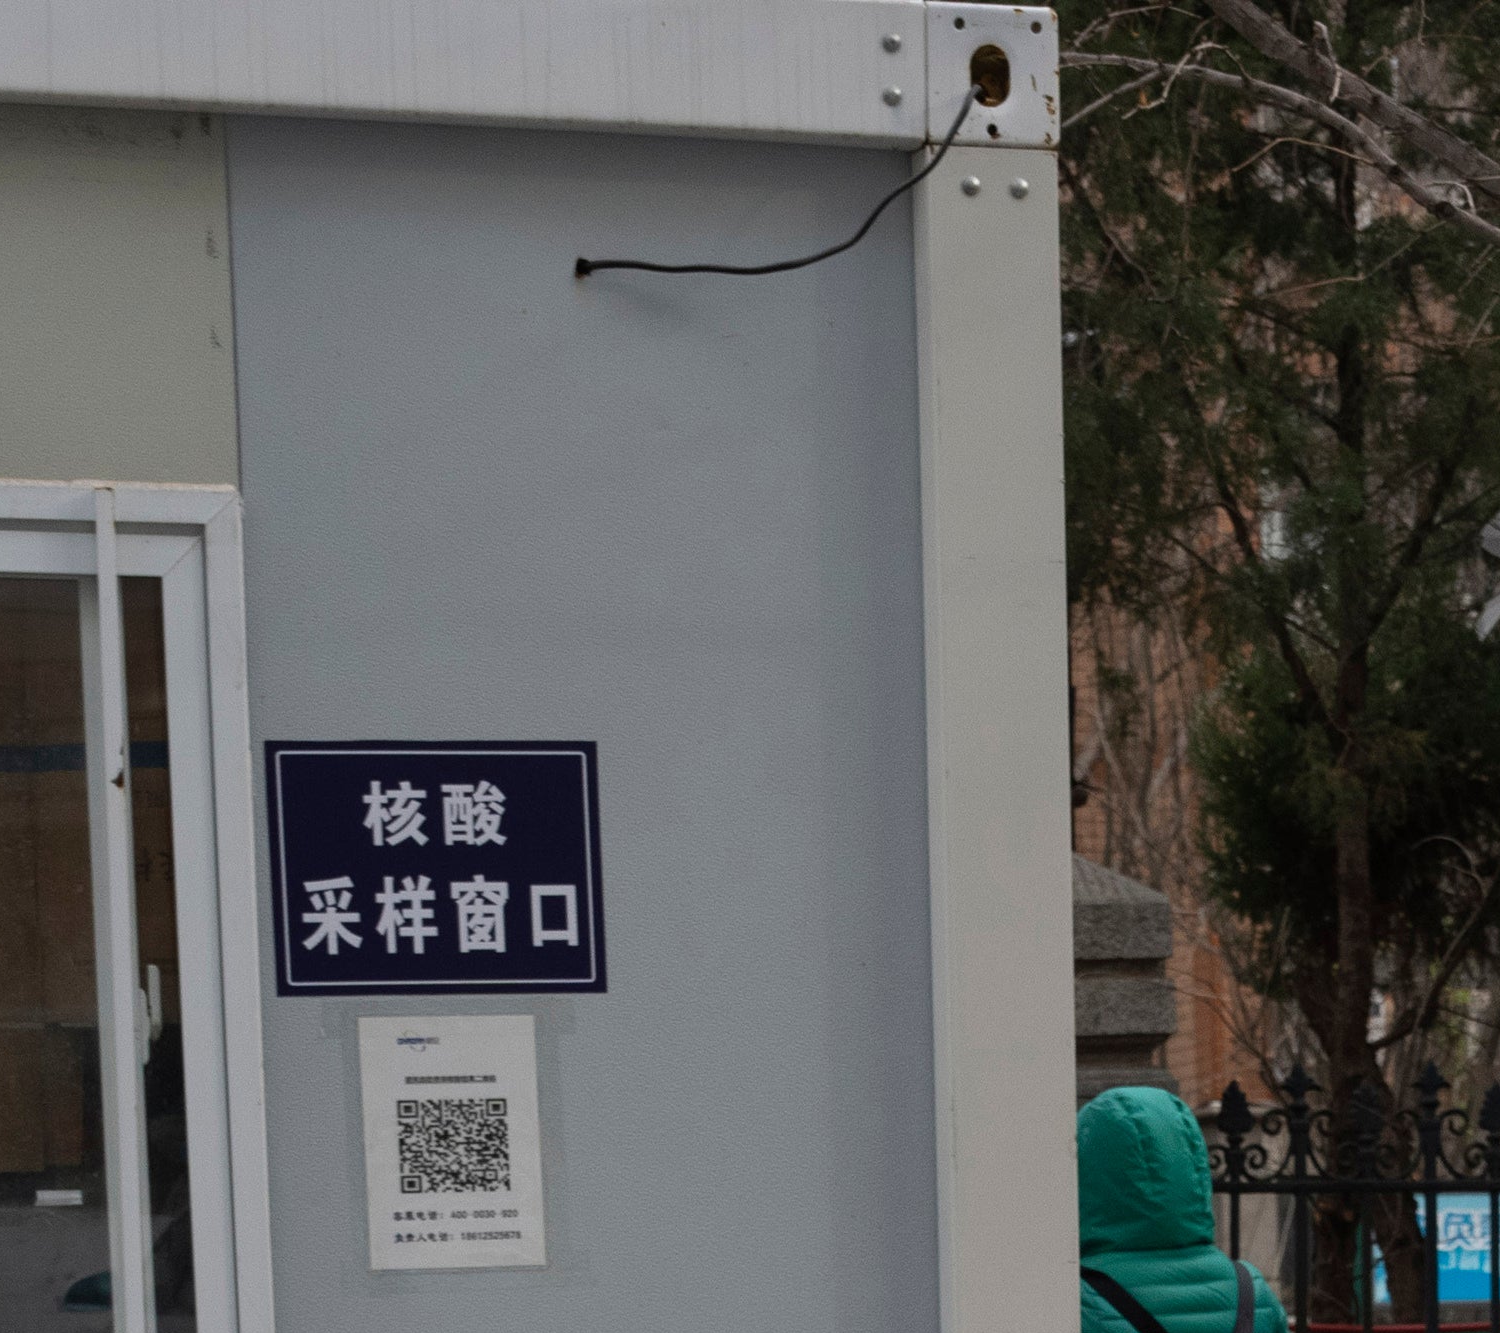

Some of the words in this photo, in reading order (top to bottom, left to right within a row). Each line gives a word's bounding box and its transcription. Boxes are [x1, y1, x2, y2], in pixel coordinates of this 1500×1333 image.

[362, 780, 508, 846] 核酸
[302, 874, 580, 955] 采样窗口
